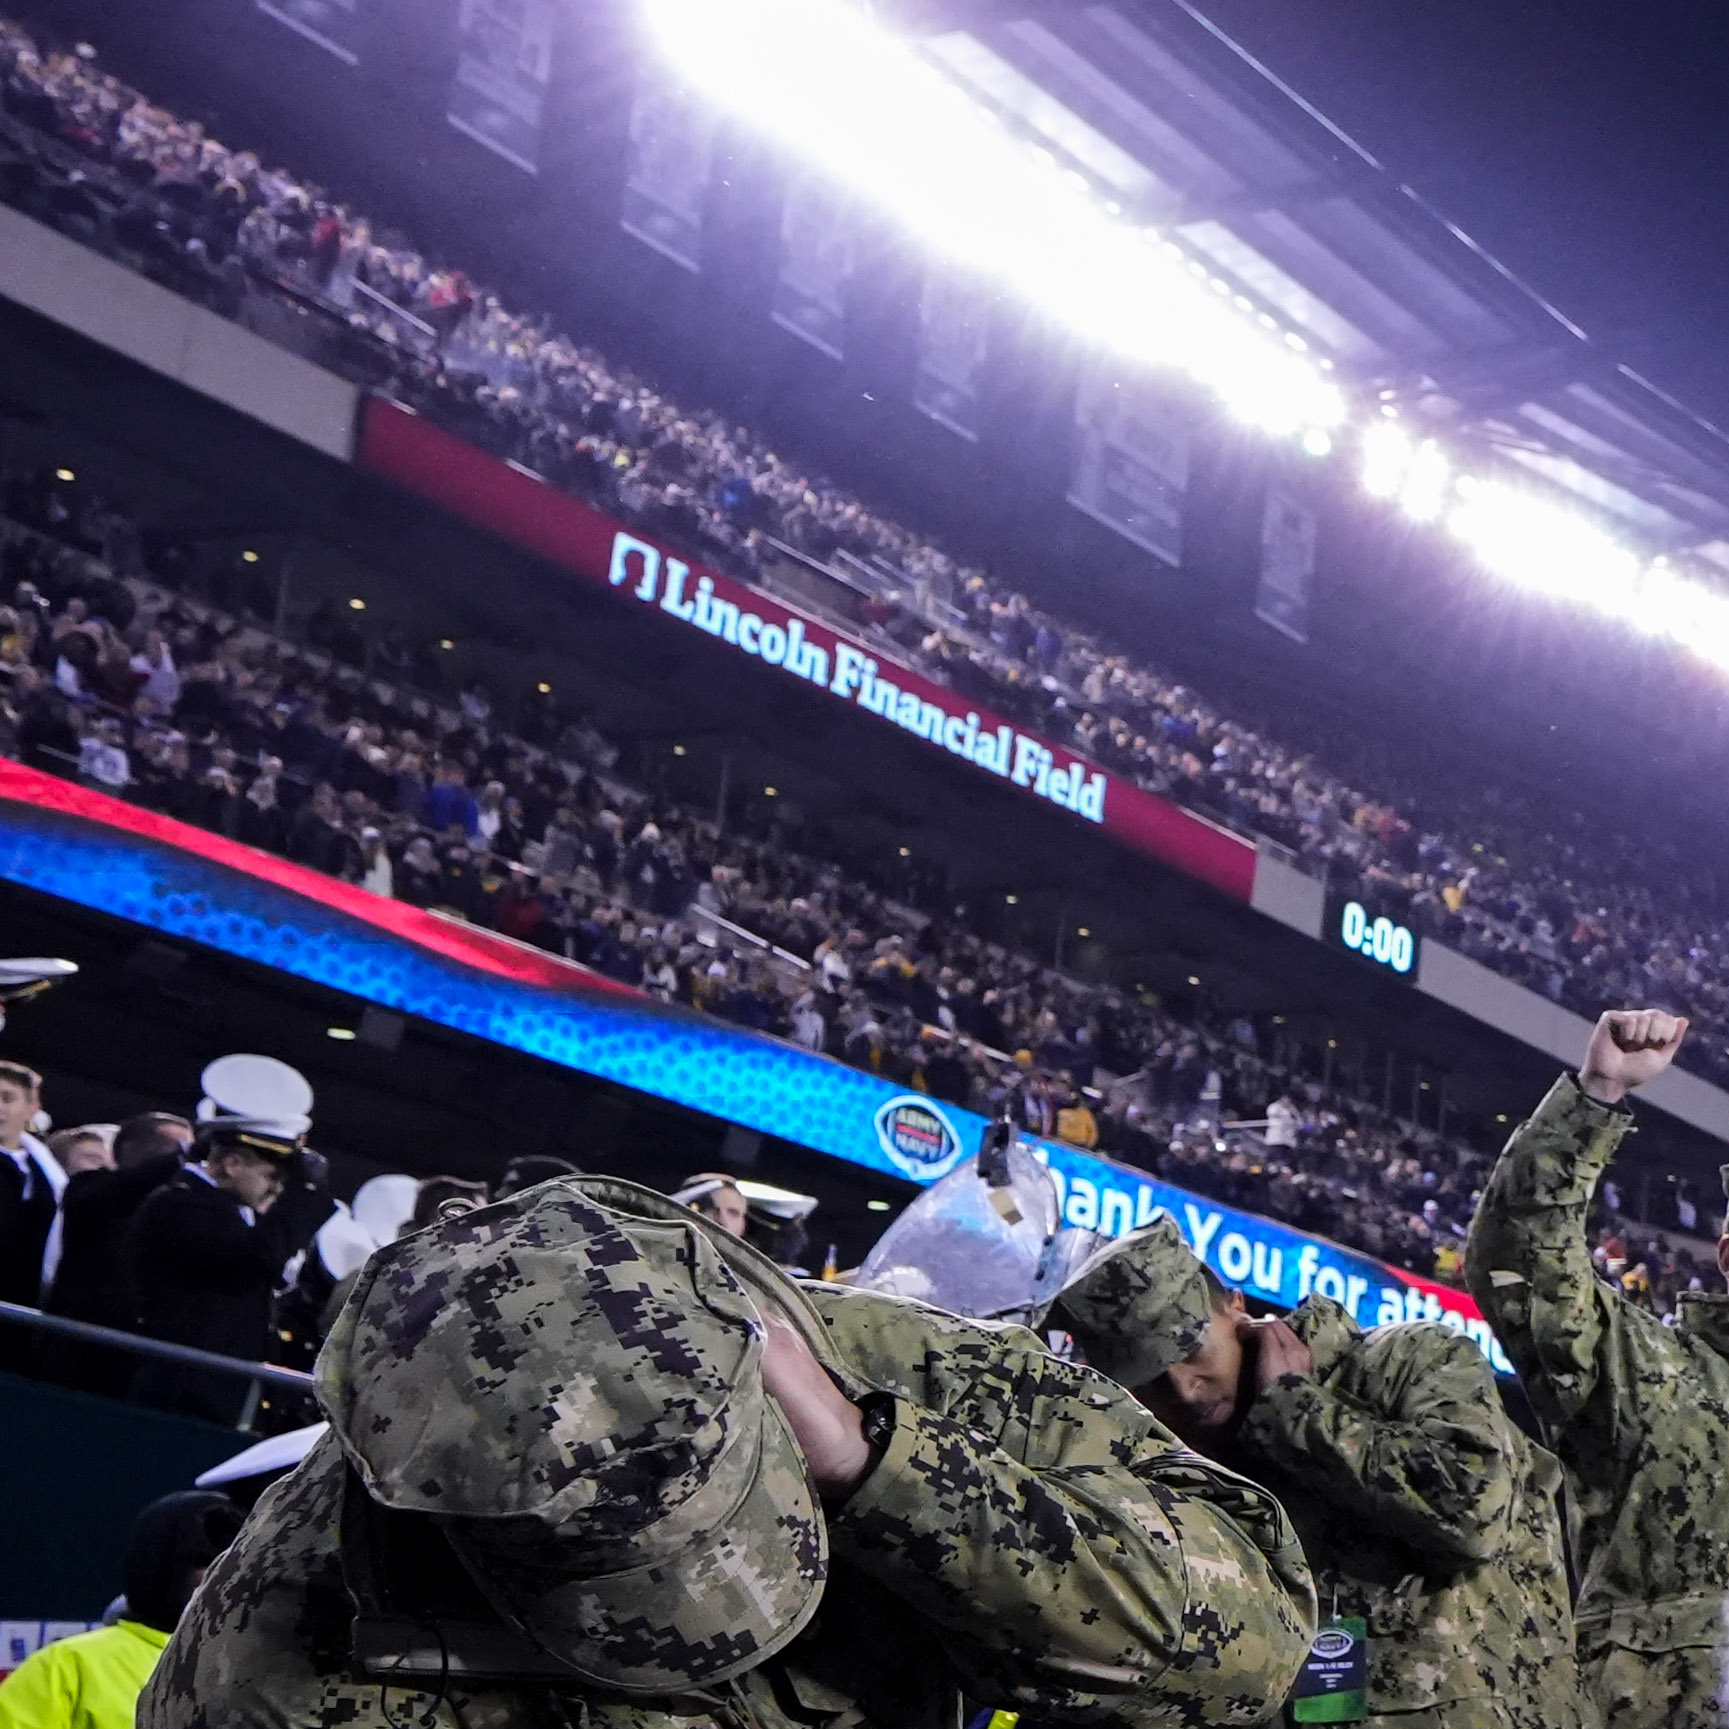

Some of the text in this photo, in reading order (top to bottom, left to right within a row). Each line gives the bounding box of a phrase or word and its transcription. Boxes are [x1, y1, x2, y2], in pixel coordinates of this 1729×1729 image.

[660, 557, 1107, 824] Lincoln Financial Field
[1342, 901, 1414, 972] 0:00
[1184, 1203, 1282, 1293] You
[1299, 1245, 1368, 1320] for
